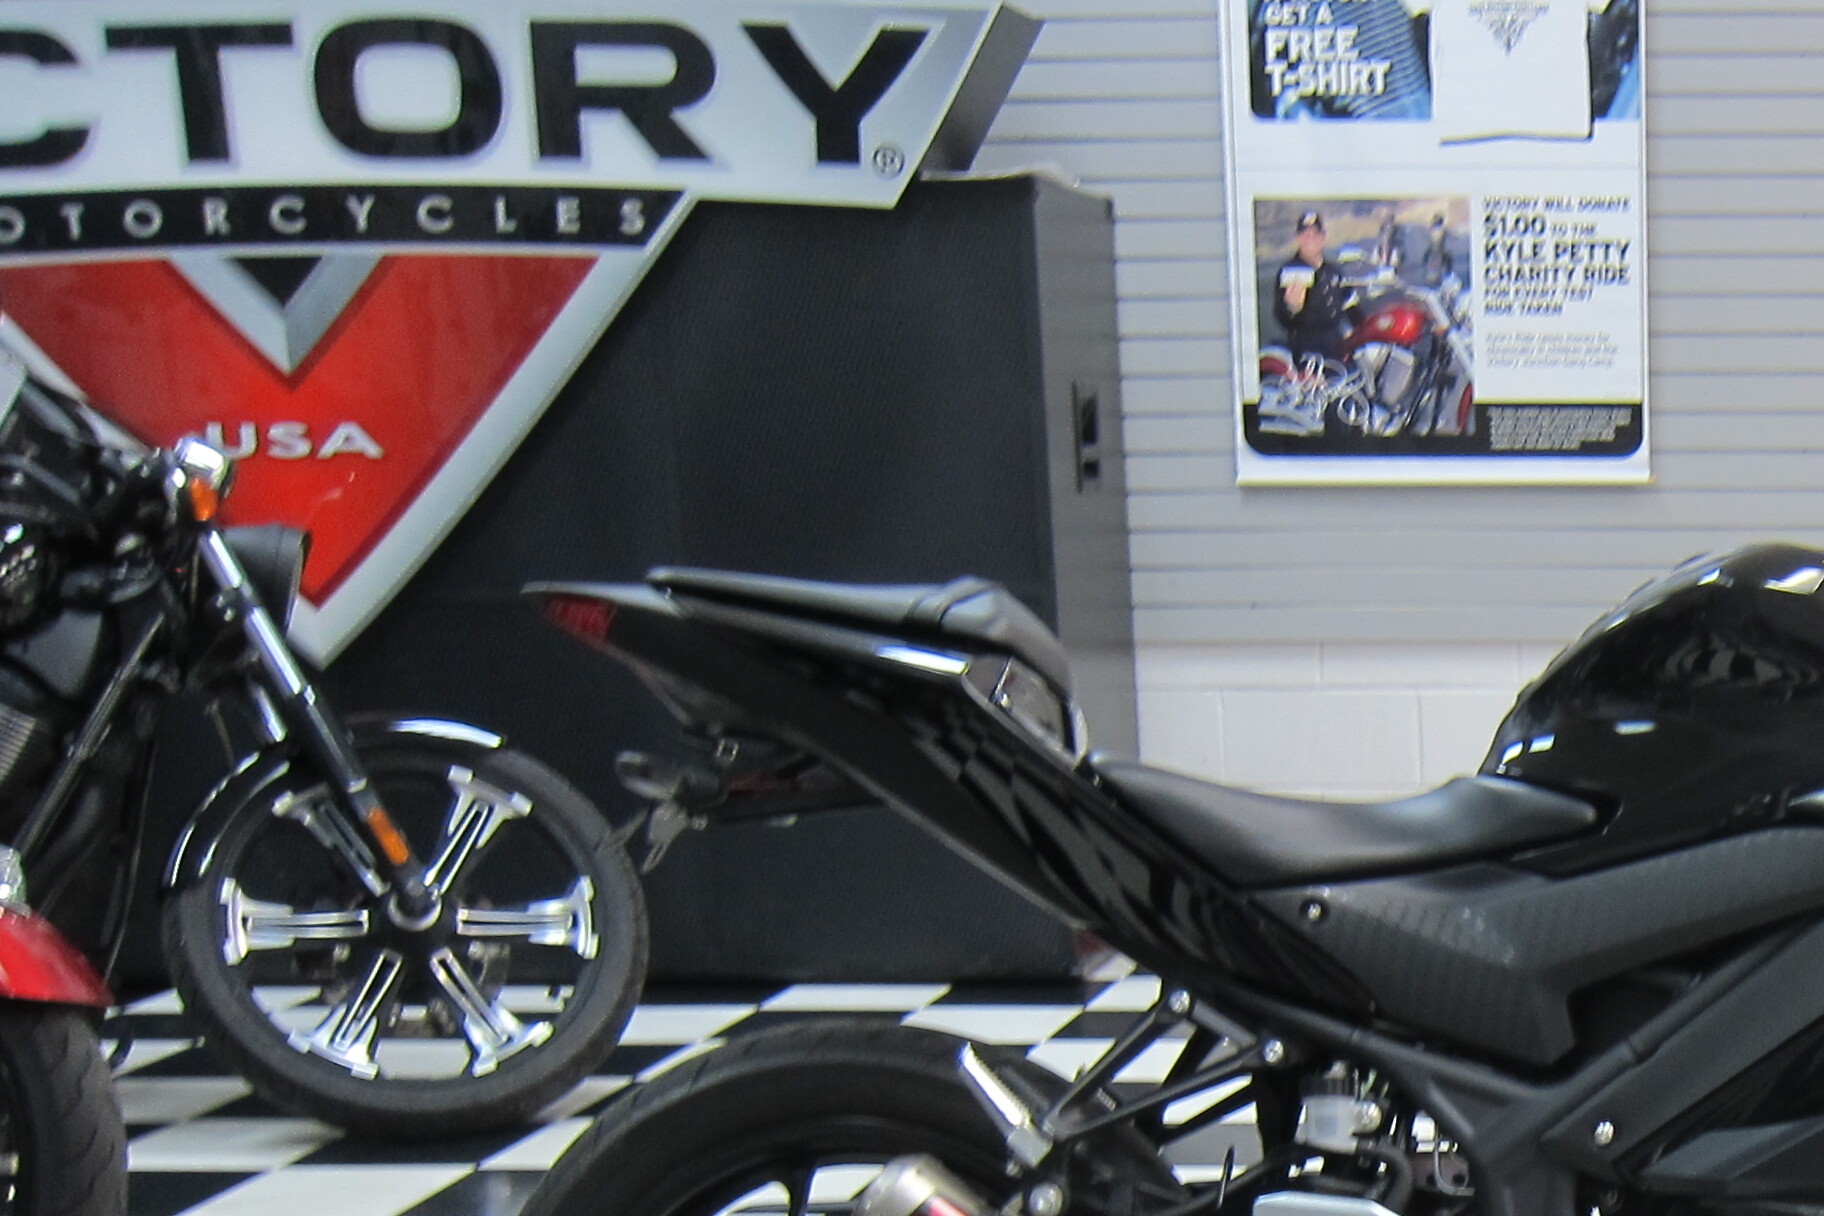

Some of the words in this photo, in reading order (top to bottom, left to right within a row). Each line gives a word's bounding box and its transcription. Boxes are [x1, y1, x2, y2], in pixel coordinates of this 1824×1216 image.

[1264, 1, 1311, 26] GET
[1315, 0, 1334, 25] A
[1264, 25, 1360, 63] FREE
[1264, 59, 1392, 97] T-SHIRT
[1484, 196, 1540, 212] VICTORY
[1545, 196, 1573, 212] WILL
[1577, 196, 1631, 213] DONATE
[1484, 213, 1547, 237] $1.00
[1484, 240, 1547, 264] KYLE
[1553, 239, 1631, 264] PETTY
[1484, 264, 1576, 285] CHARITY
[1583, 264, 1631, 286] RIDE
[1484, 286, 1510, 300] FOR
[1514, 286, 1558, 301] EVERY
[1564, 286, 1595, 302] TEST
[1484, 301, 1514, 316] RIDE
[1520, 301, 1564, 317] TAKEN
[205, 420, 385, 461] USA
